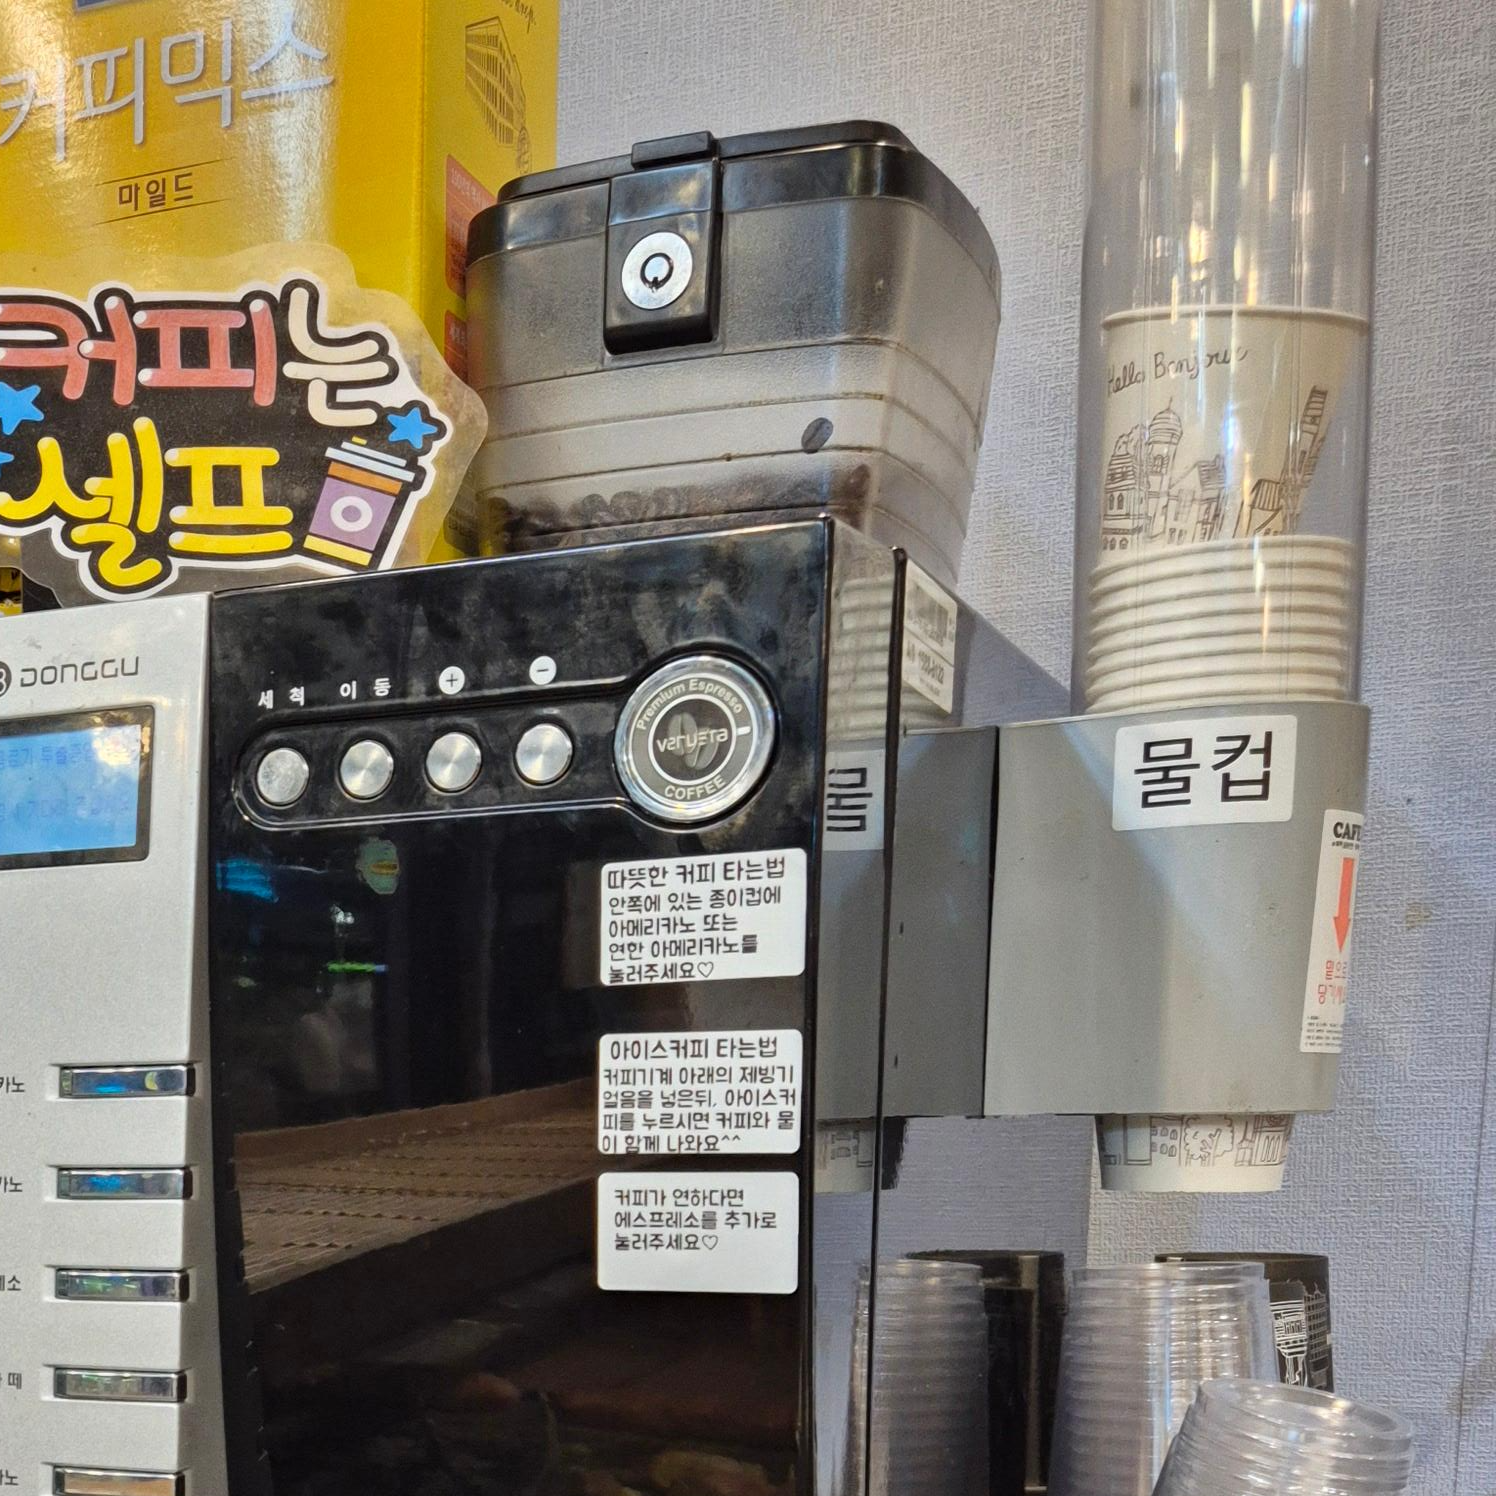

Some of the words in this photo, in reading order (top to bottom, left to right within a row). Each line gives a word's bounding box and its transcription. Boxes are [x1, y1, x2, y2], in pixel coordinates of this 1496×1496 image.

[118, 172, 195, 211] 마일드
[20, 656, 139, 687] DONGGU
[636, 682, 686, 731] Premium
[688, 678, 743, 714] Espresso
[1133, 730, 1276, 810] 물컵
[664, 775, 726, 800] COFFEE
[607, 865, 669, 890] 따뜻한
[675, 862, 716, 885] 커피
[723, 857, 785, 881] 타는법
[609, 894, 661, 914] 안쪽에
[668, 891, 702, 911] 있는
[709, 886, 781, 910] 종이컵에
[609, 915, 696, 937] 아메리카노
[704, 913, 737, 932] 또는
[609, 940, 644, 961] 연한
[651, 934, 758, 958] 아메리카노를
[611, 1039, 709, 1061] 아이스커피
[716, 1037, 777, 1058] 타는법
[603, 1068, 673, 1086] 커피기계
[679, 1066, 733, 1085] 아래의
[740, 1065, 794, 1084] 제빙기
[603, 1090, 653, 1108] 얼음을
[726, 1088, 796, 1107] 아이스커
[603, 1112, 635, 1131] 피를
[643, 1112, 710, 1130] 누르시면
[716, 1112, 770, 1129] 커피와
[778, 1110, 795, 1130] 물
[603, 1135, 617, 1152] 이
[625, 1135, 659, 1153] 함께
[615, 1189, 666, 1207] 커피가
[673, 1189, 744, 1208] 연하다면
[615, 1211, 717, 1230] 에스프레소를
[725, 1211, 777, 1229] 추가로
